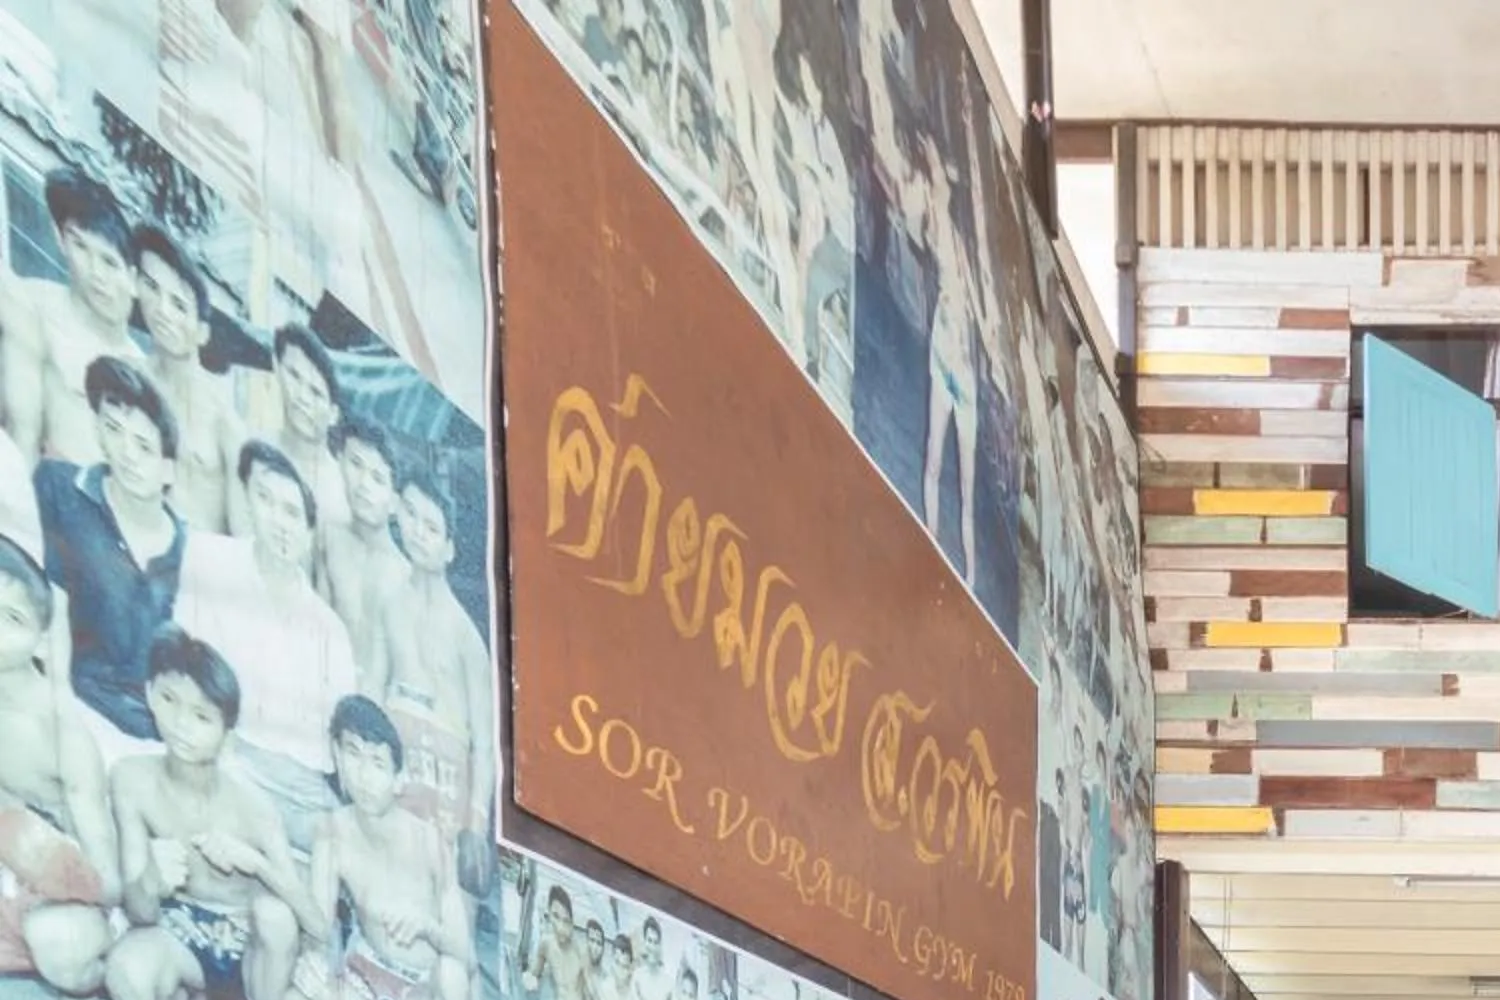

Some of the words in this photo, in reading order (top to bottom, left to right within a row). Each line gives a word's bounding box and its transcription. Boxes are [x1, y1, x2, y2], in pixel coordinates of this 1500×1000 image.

[554, 694, 695, 834] SOR
[708, 788, 908, 964] VORAPIN
[914, 926, 977, 992] GYM
